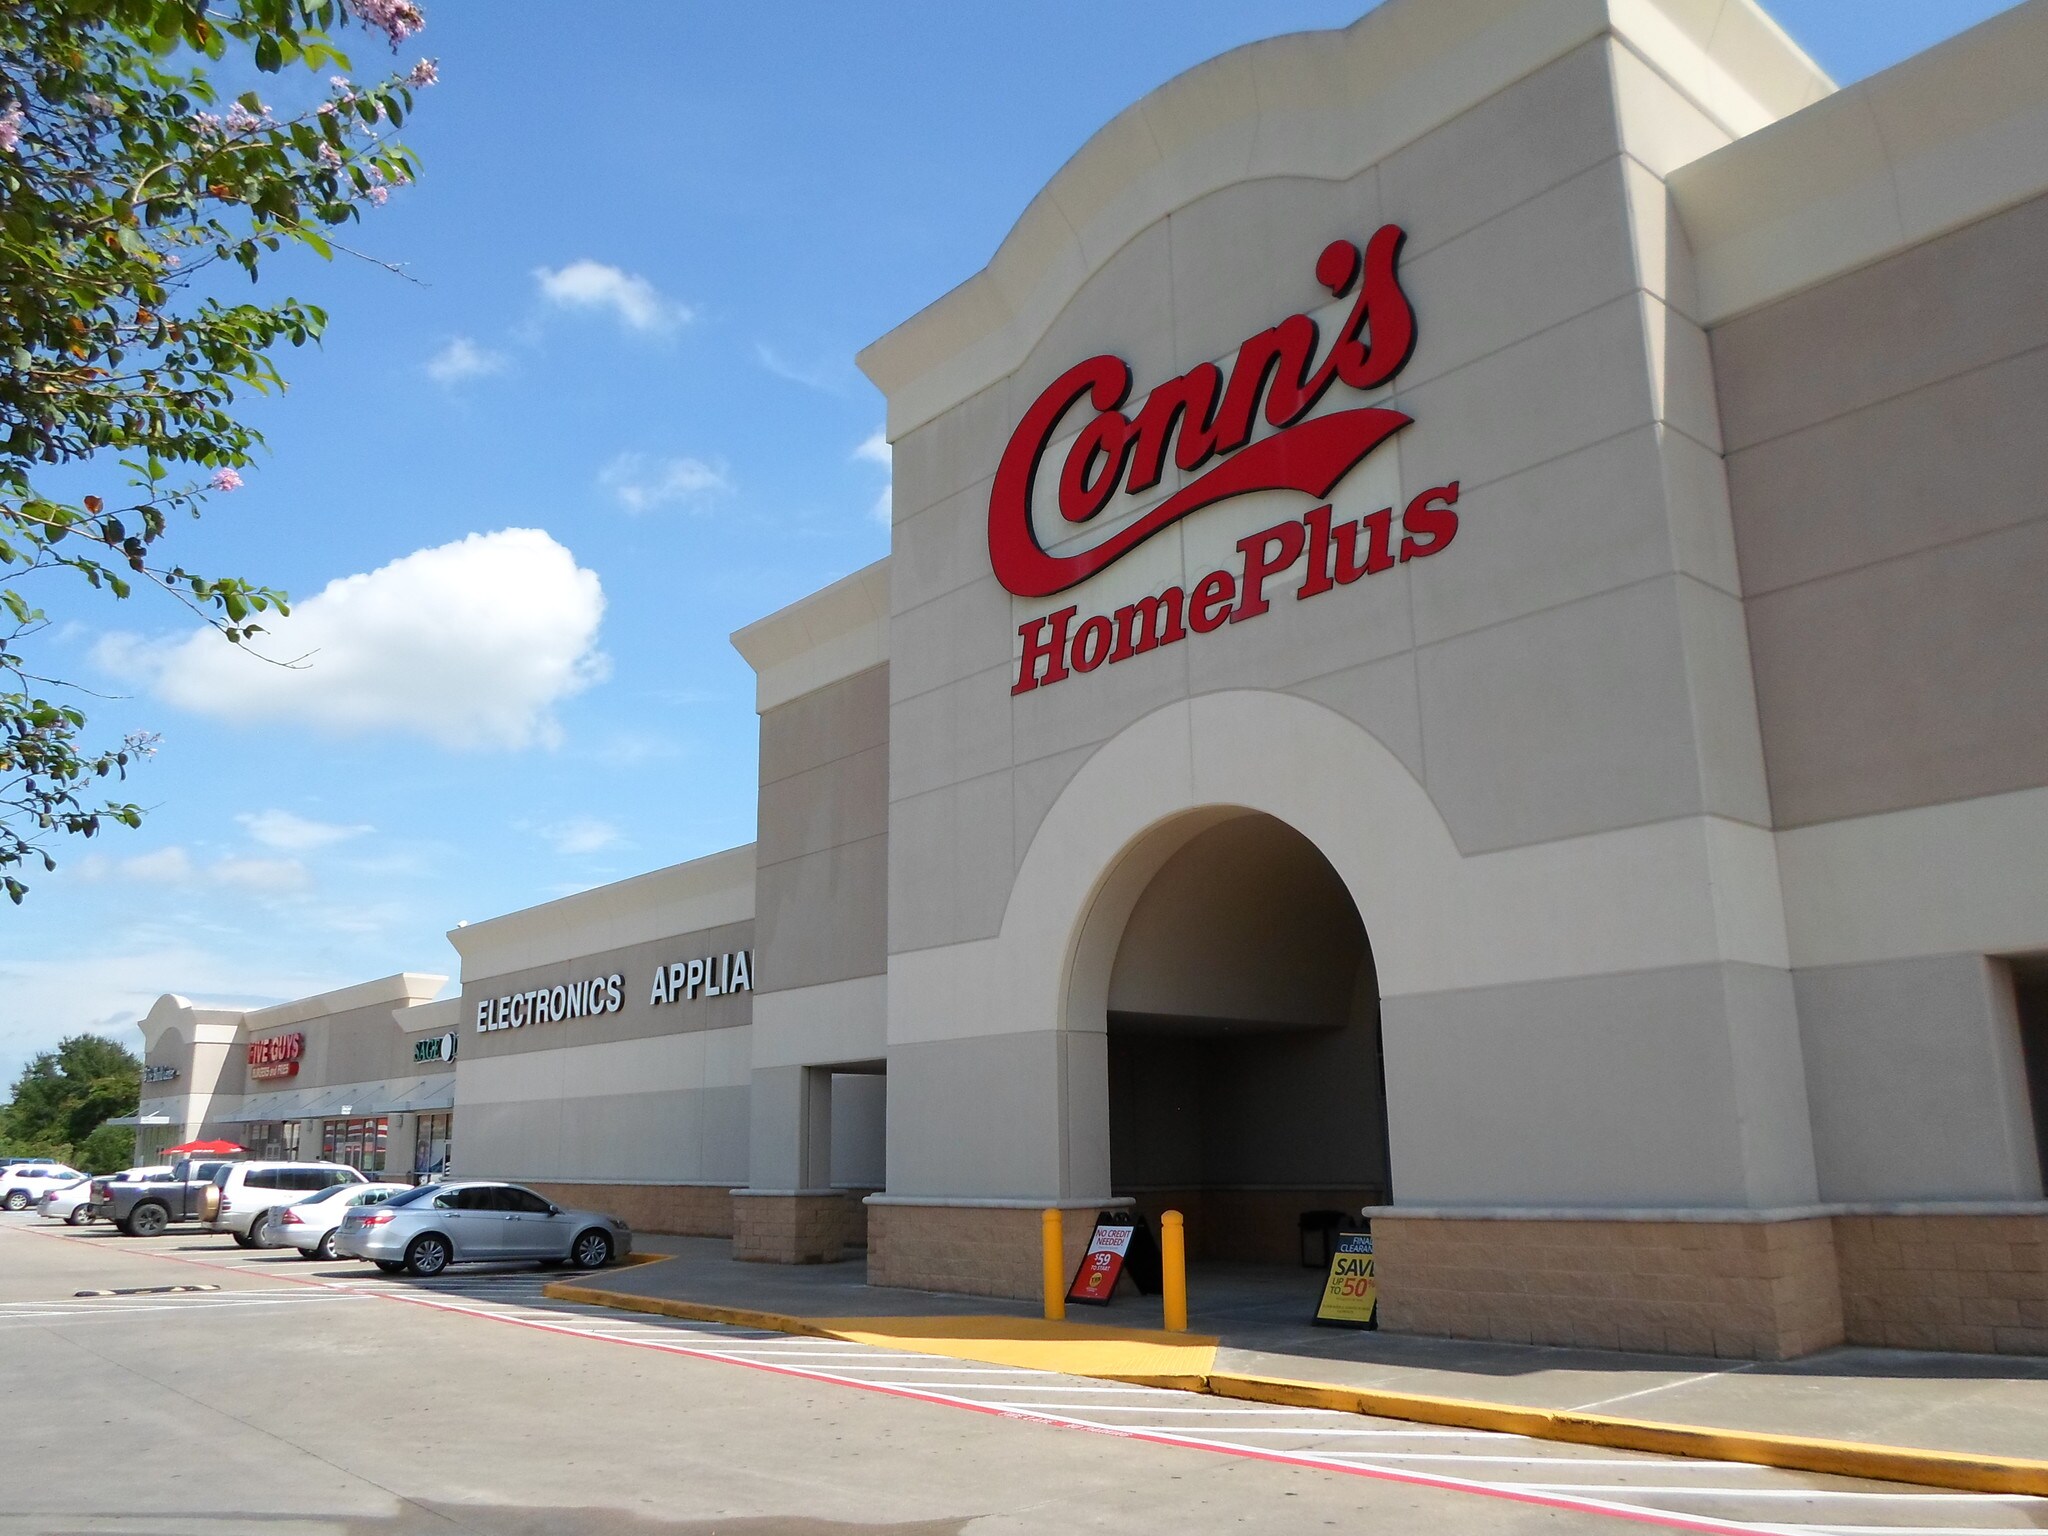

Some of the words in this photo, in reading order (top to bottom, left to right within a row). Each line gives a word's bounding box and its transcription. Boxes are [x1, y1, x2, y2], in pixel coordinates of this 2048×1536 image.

[988, 224, 1418, 597] Conn's
[1011, 481, 1460, 696] HomePlus
[477, 973, 625, 1033] ELECTRONICS
[650, 949, 754, 1005] APPLIA
[248, 1039, 270, 1064] FIVE
[270, 1033, 300, 1061] GUYS
[1096, 1229, 1107, 1237] NO
[1108, 1229, 1131, 1238] CREDIT
[1096, 1238, 1124, 1246] NEEDED!
[1094, 1253, 1111, 1265] $59
[1330, 1286, 1341, 1295] TO
